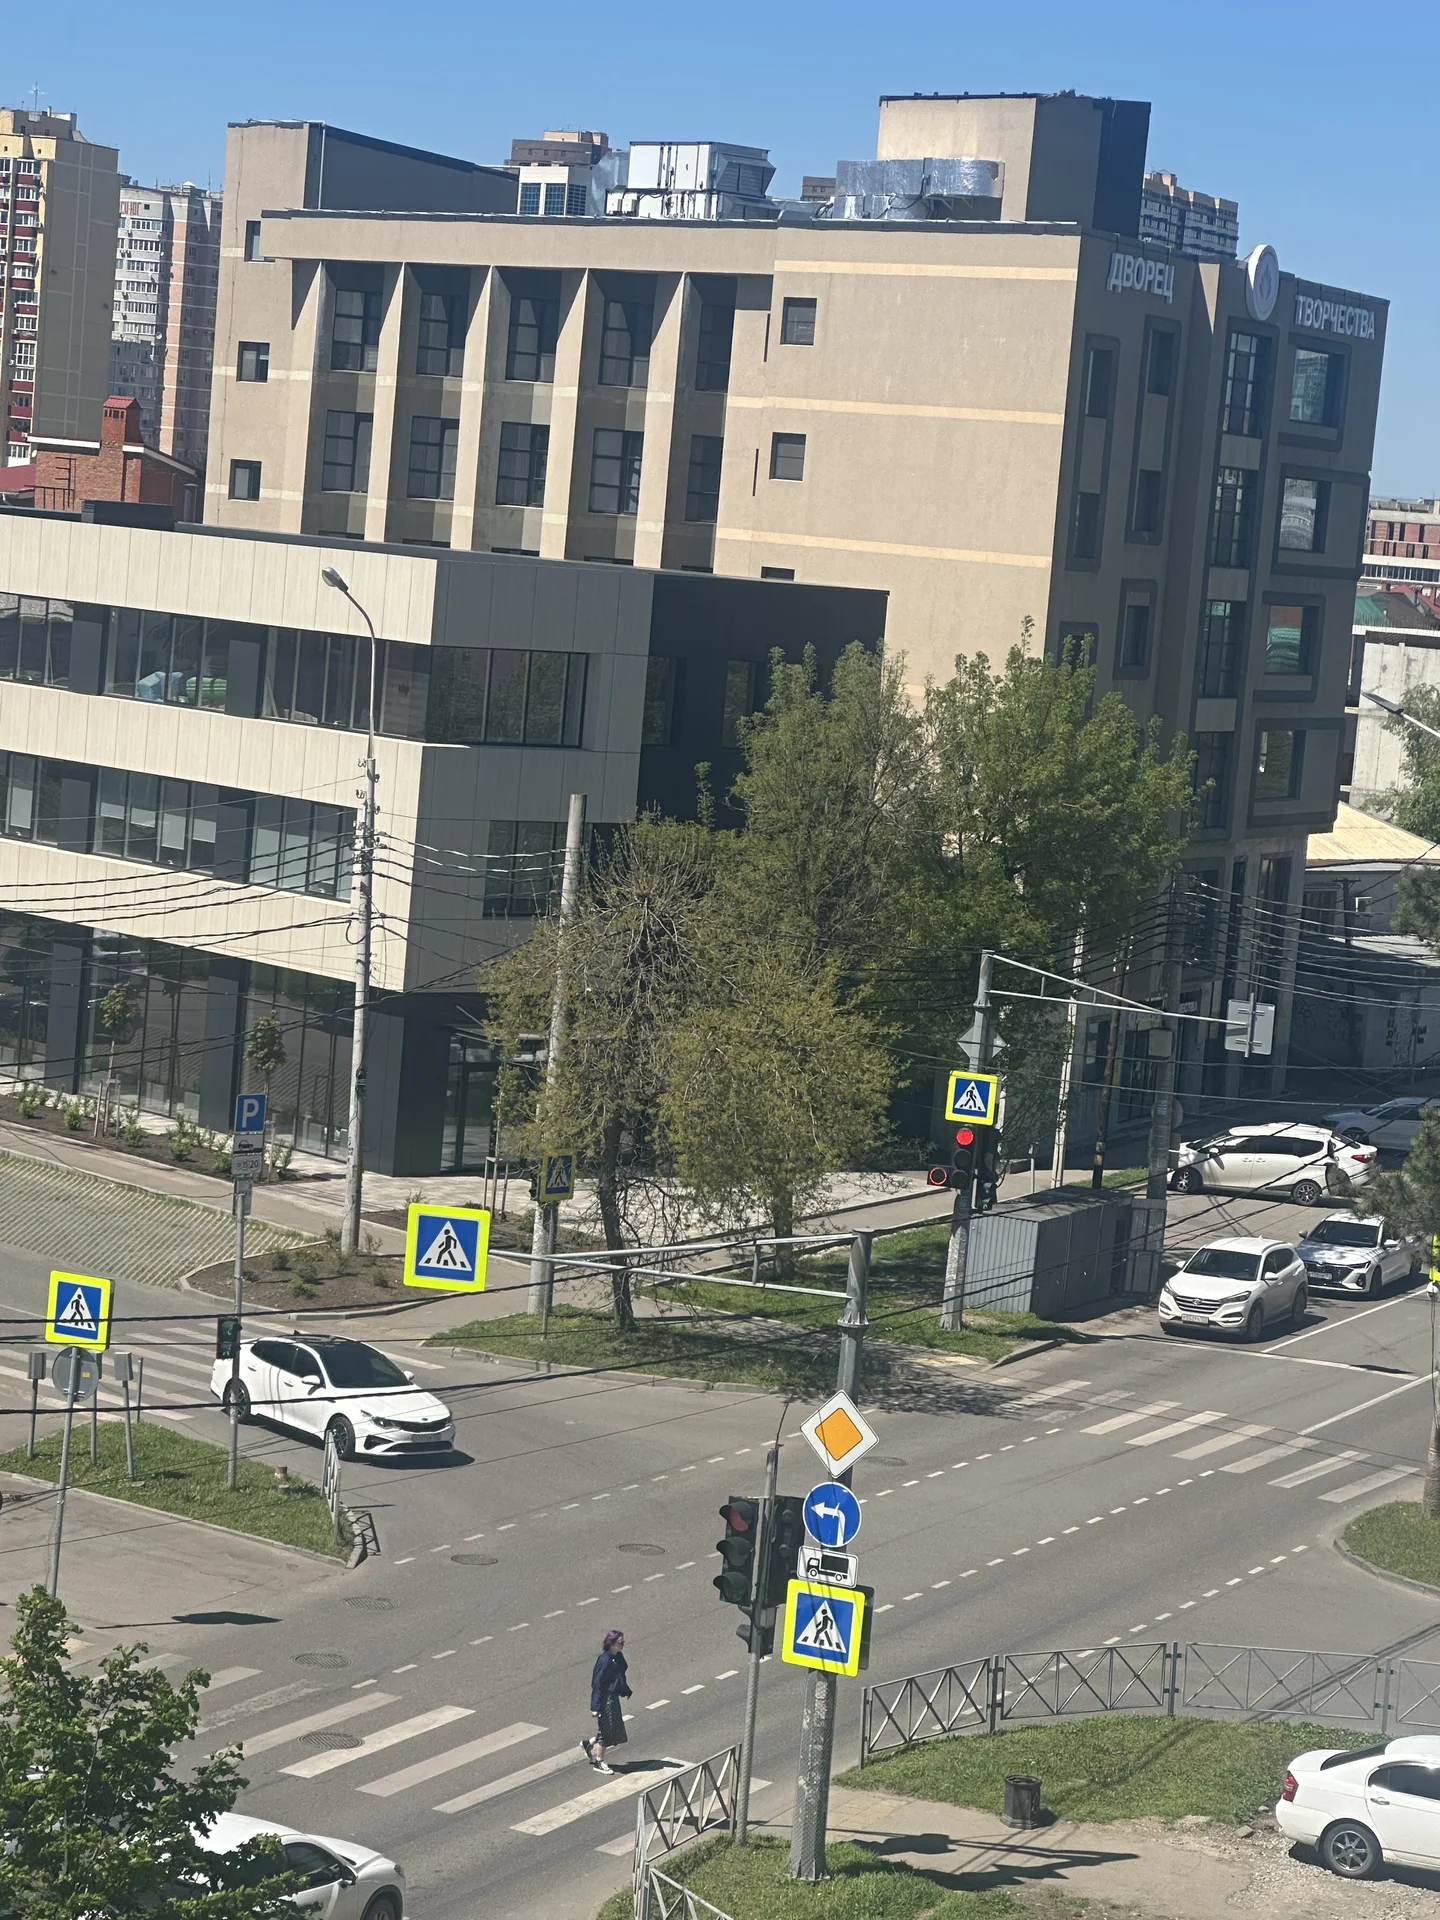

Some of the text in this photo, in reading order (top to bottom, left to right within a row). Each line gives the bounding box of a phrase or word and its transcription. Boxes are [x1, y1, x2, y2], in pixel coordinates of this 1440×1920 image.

[1107, 252, 1175, 304] ДВОРЕЦ
[1295, 294, 1375, 340] ТВОРЧЕСТВА
[242, 1099, 259, 1128] P
[249, 1159, 259, 1169] 20
